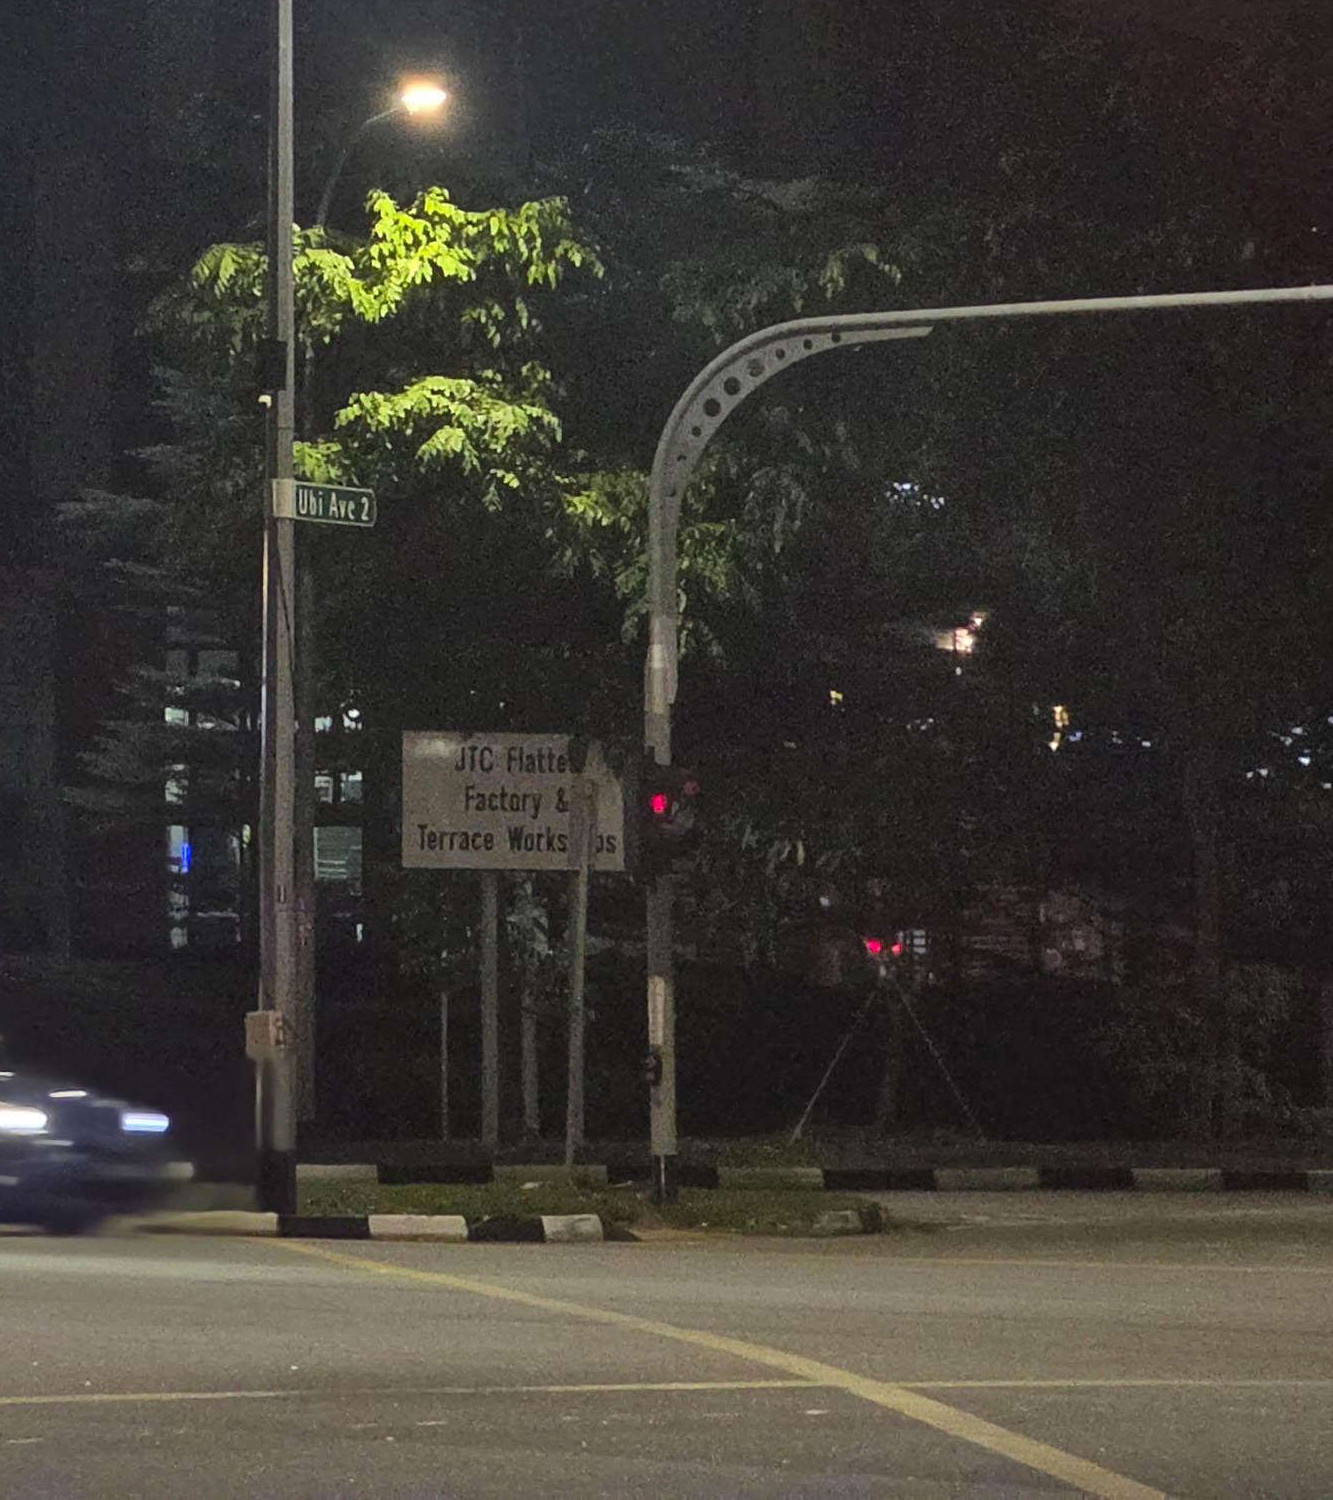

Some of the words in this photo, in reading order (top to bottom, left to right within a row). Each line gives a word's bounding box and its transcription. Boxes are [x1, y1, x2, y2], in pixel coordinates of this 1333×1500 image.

[298, 488, 323, 516] Ubi
[329, 491, 355, 520] Ave
[361, 496, 369, 521] 2
[454, 745, 494, 774] JTC
[506, 746, 575, 774] Flatte
[464, 784, 541, 820] Factory
[555, 786, 569, 813] &
[417, 823, 494, 852] Terrace
